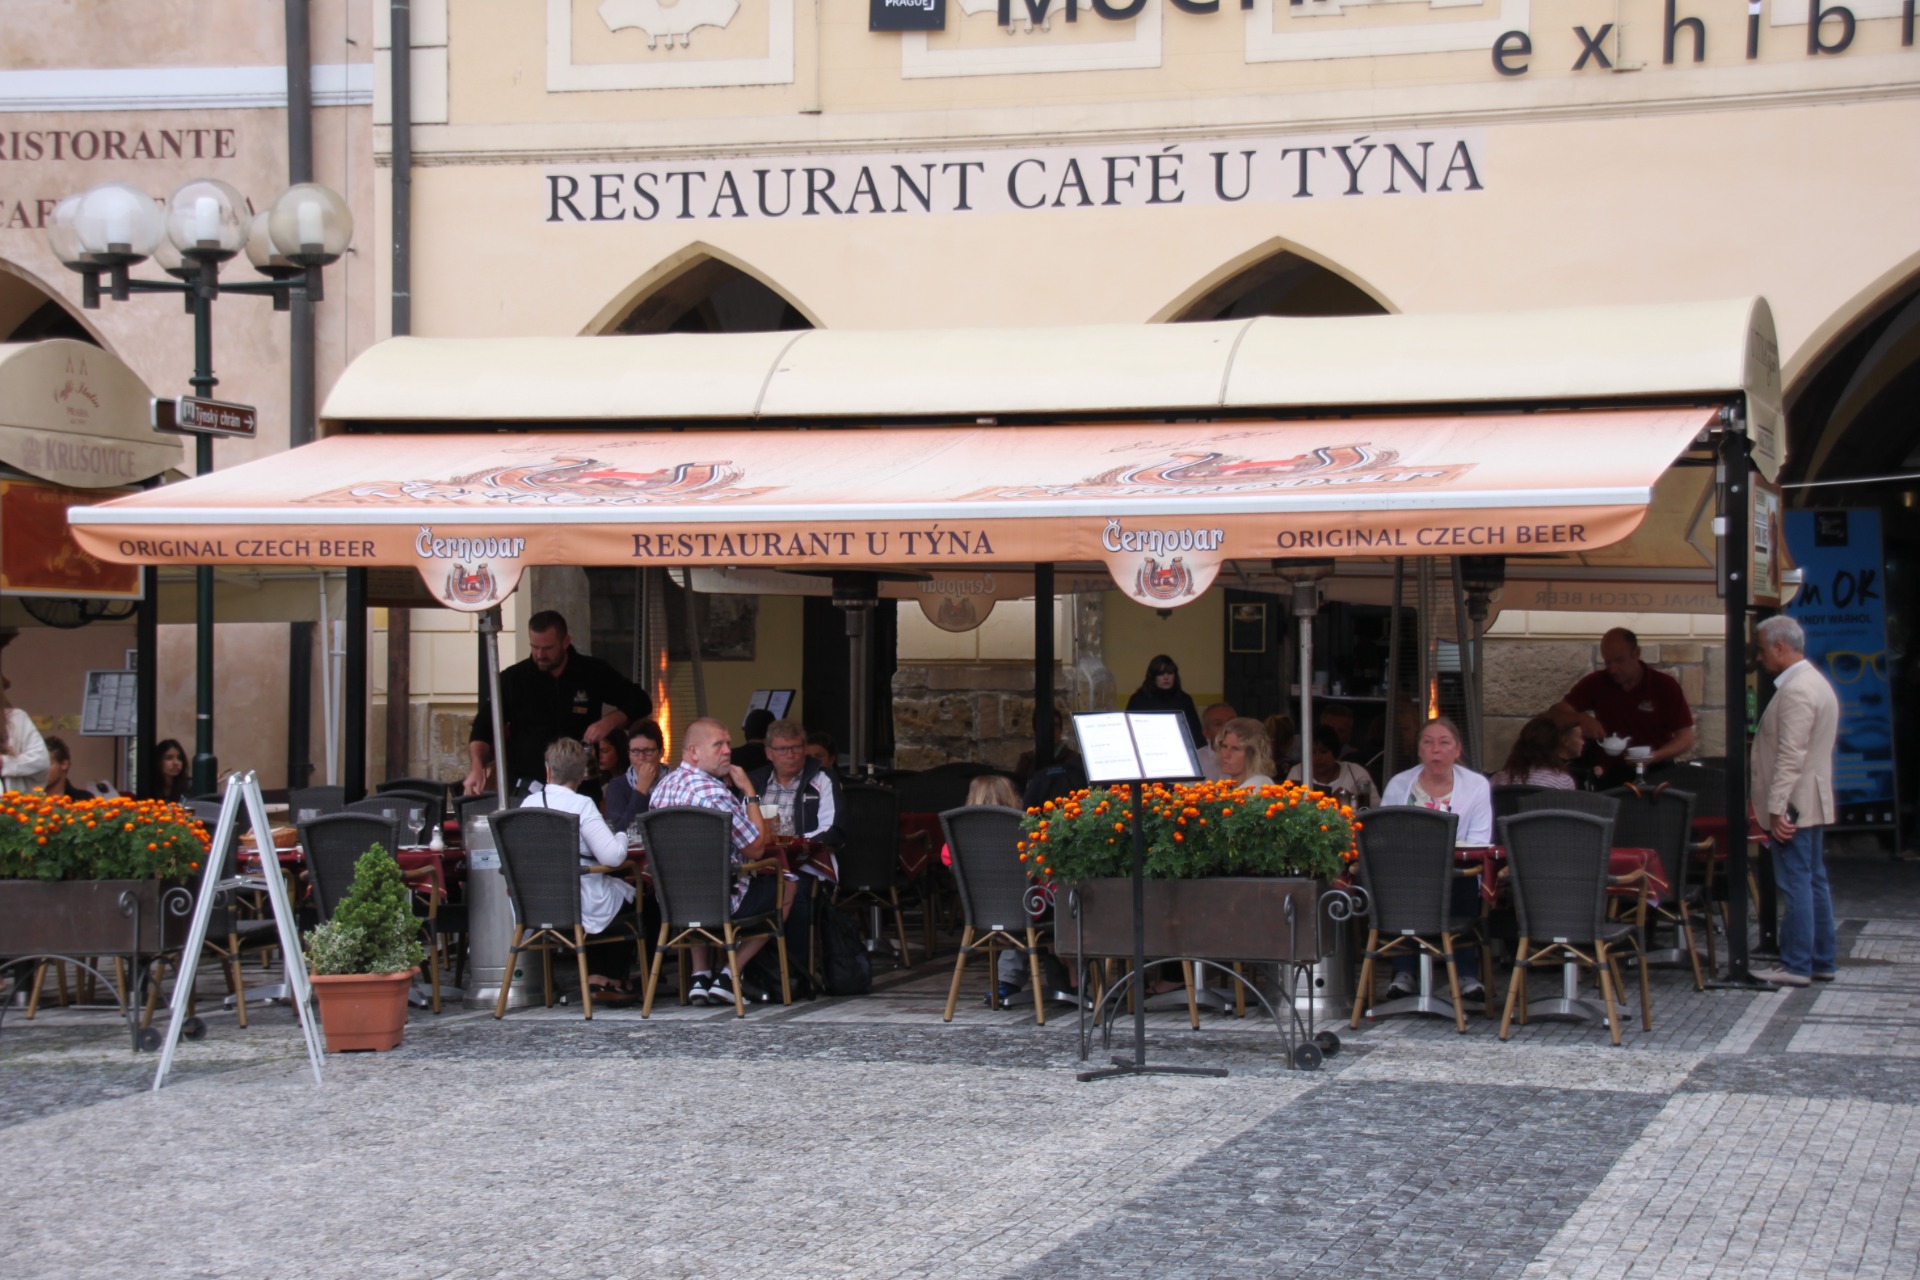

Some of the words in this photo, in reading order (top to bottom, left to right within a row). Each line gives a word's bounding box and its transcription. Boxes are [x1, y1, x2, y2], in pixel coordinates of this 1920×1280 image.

[0, 128, 236, 161] ISTORANTE
[546, 162, 985, 222] RESTAURANT
[1006, 145, 1185, 209] CAFÉ
[1209, 150, 1257, 202] U
[1281, 135, 1484, 198] TÝNA
[195, 405, 219, 428] Týnský
[220, 410, 241, 428] chrám
[45, 438, 136, 478] KRUŠOVICE
[119, 540, 229, 558] ORIGINAL
[235, 540, 311, 557] CZECH
[318, 540, 377, 558] BEER
[415, 524, 527, 563] Černovar
[632, 532, 855, 558] RESTAURANT
[866, 531, 889, 556] U
[900, 524, 995, 555] TÝNA
[1101, 517, 1226, 557] Černovar
[1276, 528, 1408, 548] ORIGINAL
[1416, 525, 1505, 546] CZECH
[1516, 524, 1587, 545] BEER
